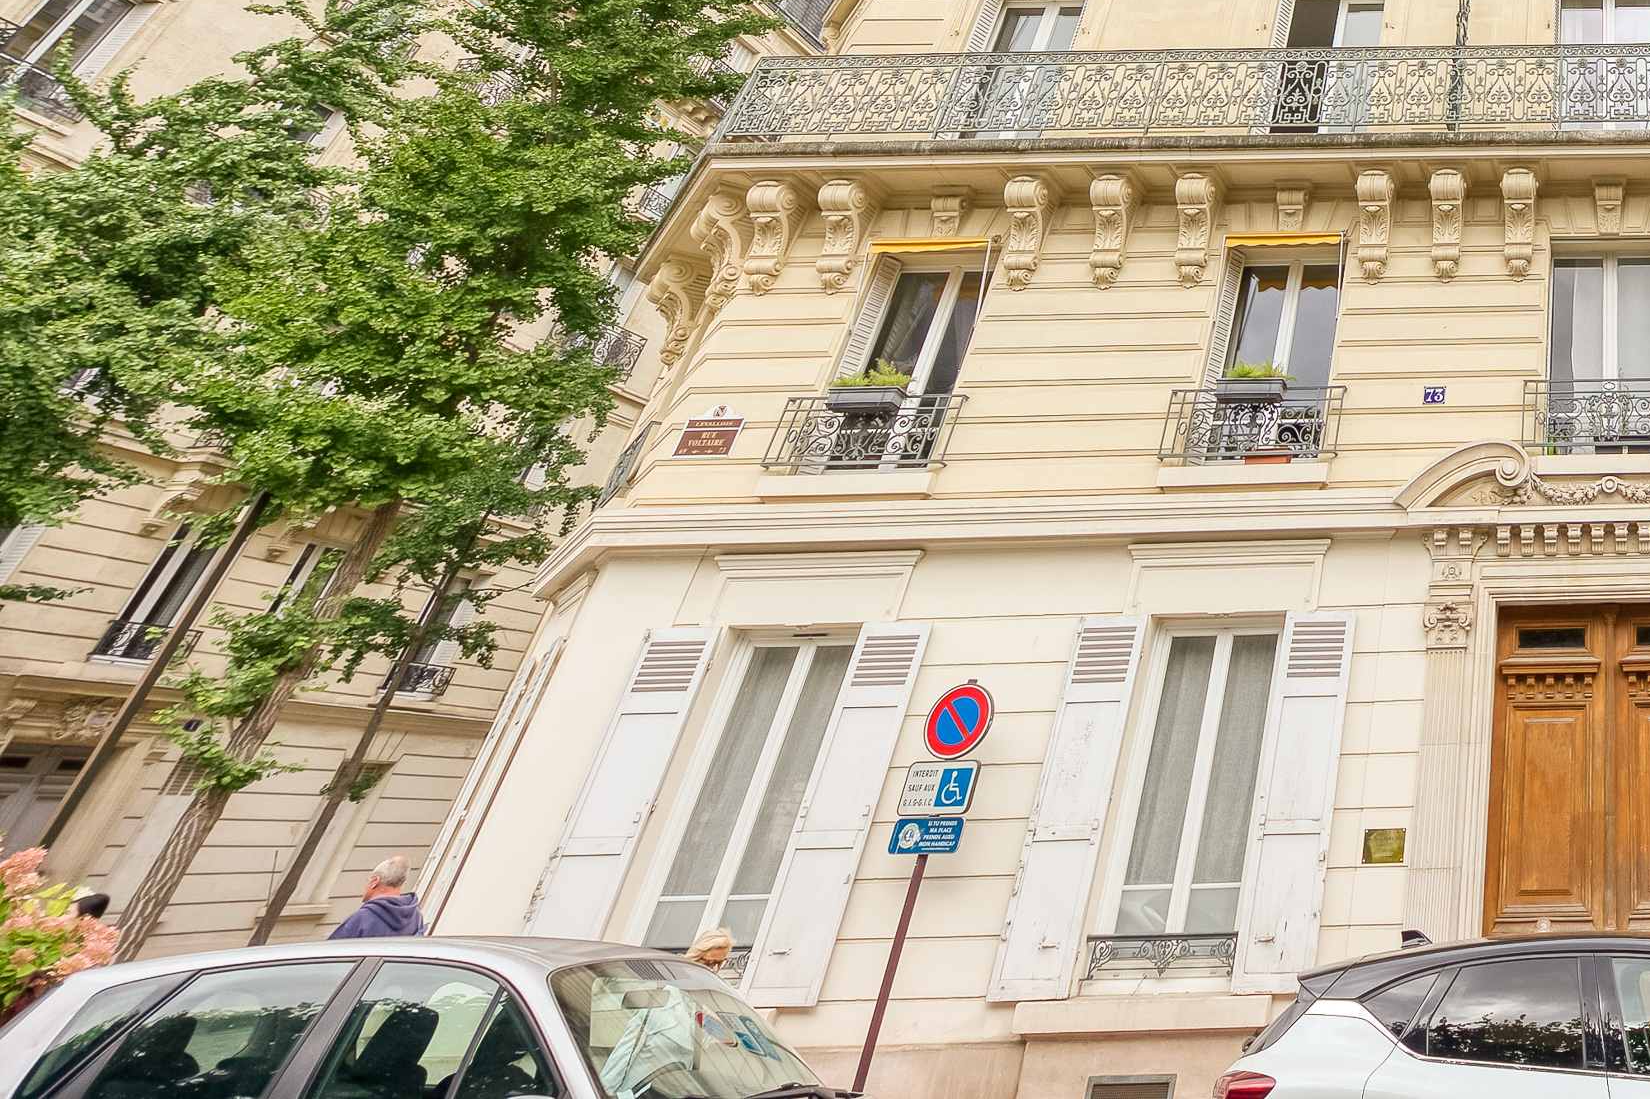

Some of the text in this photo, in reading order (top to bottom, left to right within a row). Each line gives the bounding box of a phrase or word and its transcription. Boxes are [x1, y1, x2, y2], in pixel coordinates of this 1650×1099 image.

[1425, 388, 1444, 402] 73
[700, 431, 718, 439] RUE
[687, 439, 725, 447] VOLTAIRE
[912, 769, 939, 778] INTERDIT
[907, 784, 936, 792] SAUF AUX
